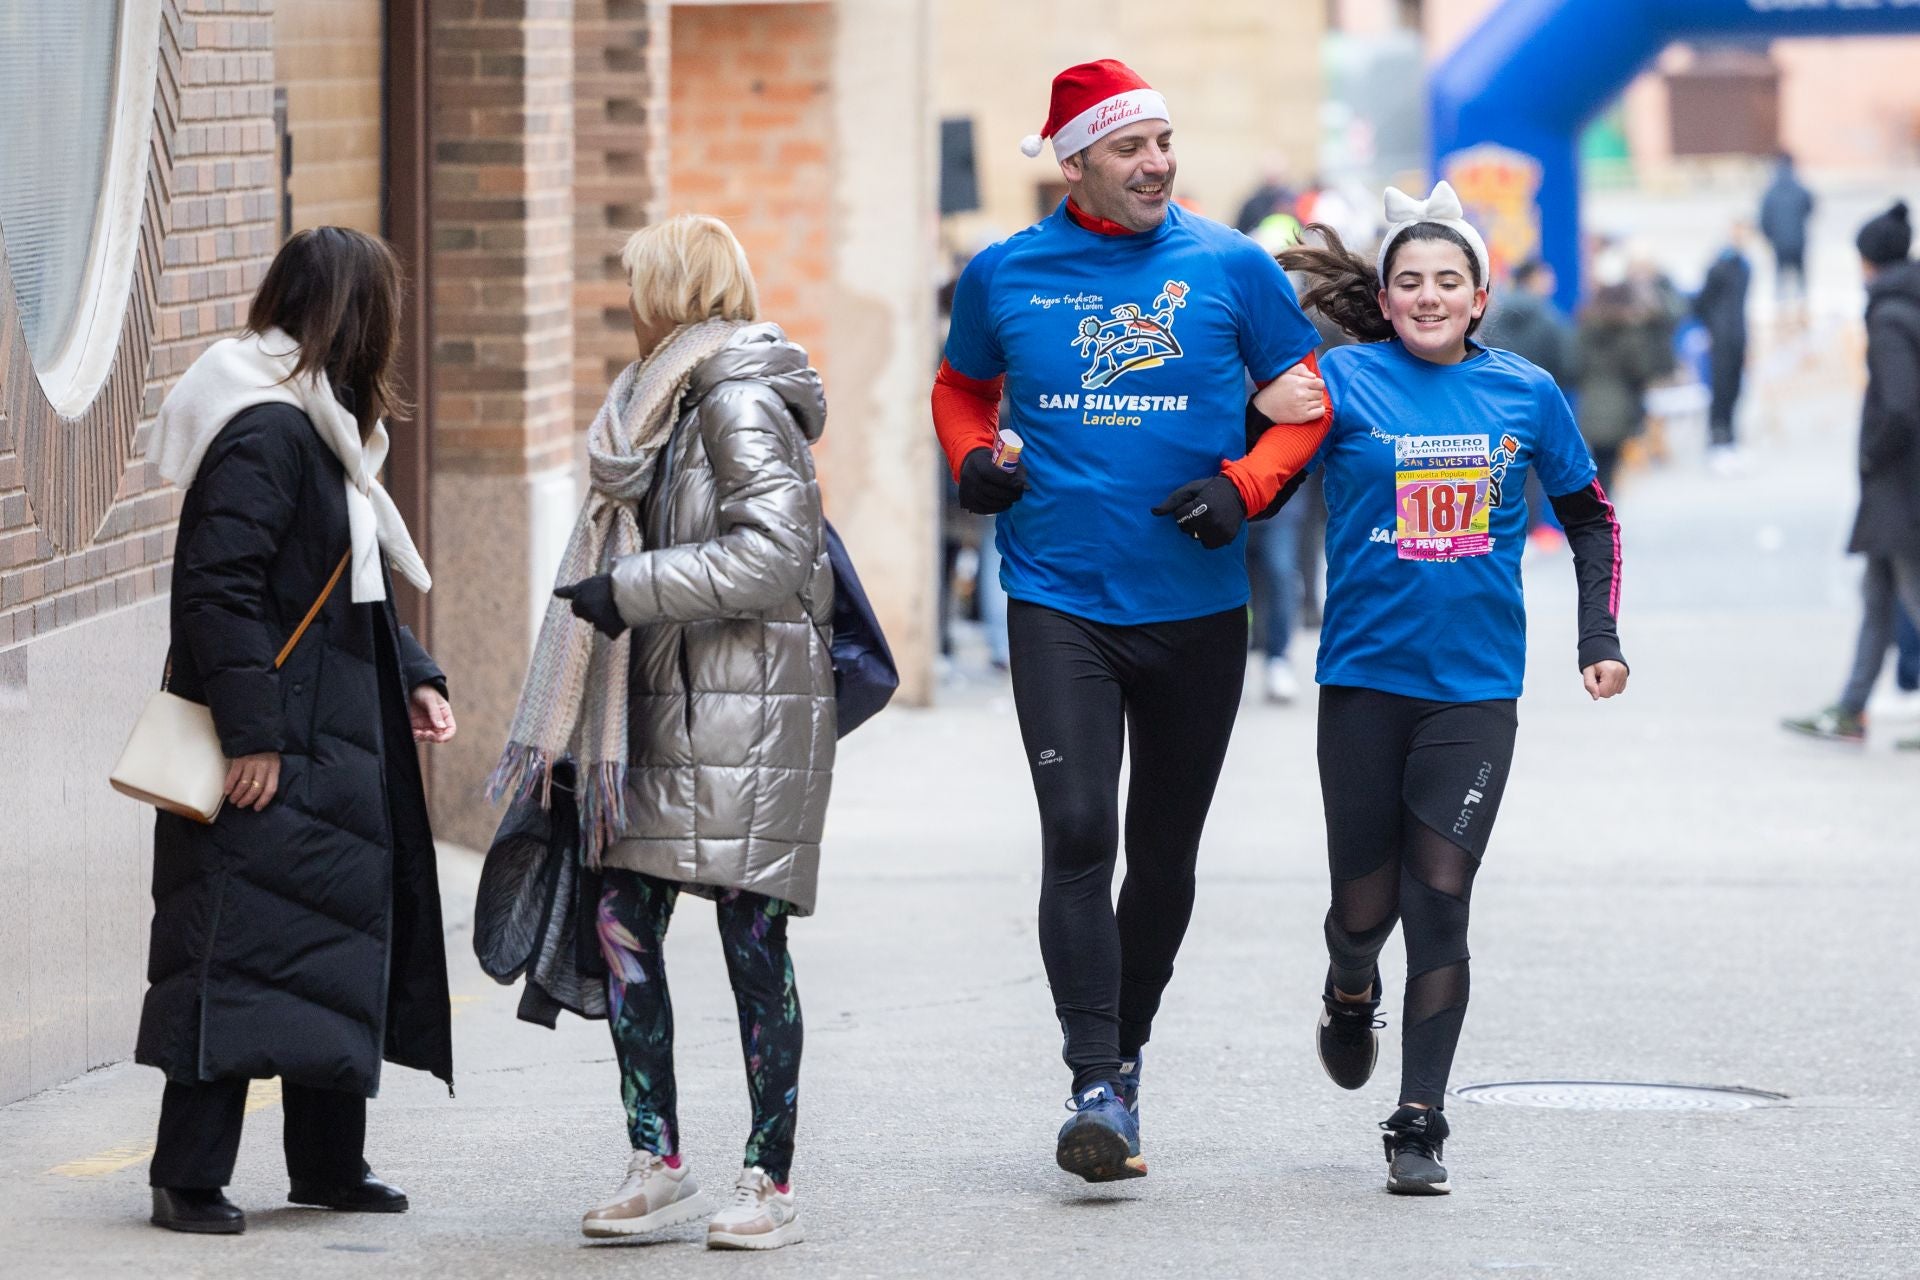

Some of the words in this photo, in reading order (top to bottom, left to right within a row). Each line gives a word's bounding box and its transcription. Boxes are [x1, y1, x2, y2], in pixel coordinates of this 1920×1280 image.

[1097, 99, 1130, 120] Feliz
[1088, 104, 1143, 135] Navidad
[1030, 293, 1061, 309] Amigos
[1082, 302, 1104, 310] Lardero
[1039, 394, 1079, 409] SAN
[1083, 394, 1189, 412] SILVESTRE
[1082, 412, 1142, 426] Lardero
[1411, 438, 1483, 448] LARDERO
[1409, 446, 1485, 455] ayuntamiento
[1404, 458, 1424, 467] SAN
[1428, 457, 1485, 467] SILVESTRE
[1440, 470, 1467, 479] Popular
[1411, 483, 1478, 533] 187
[1416, 538, 1453, 552] PEVISA
